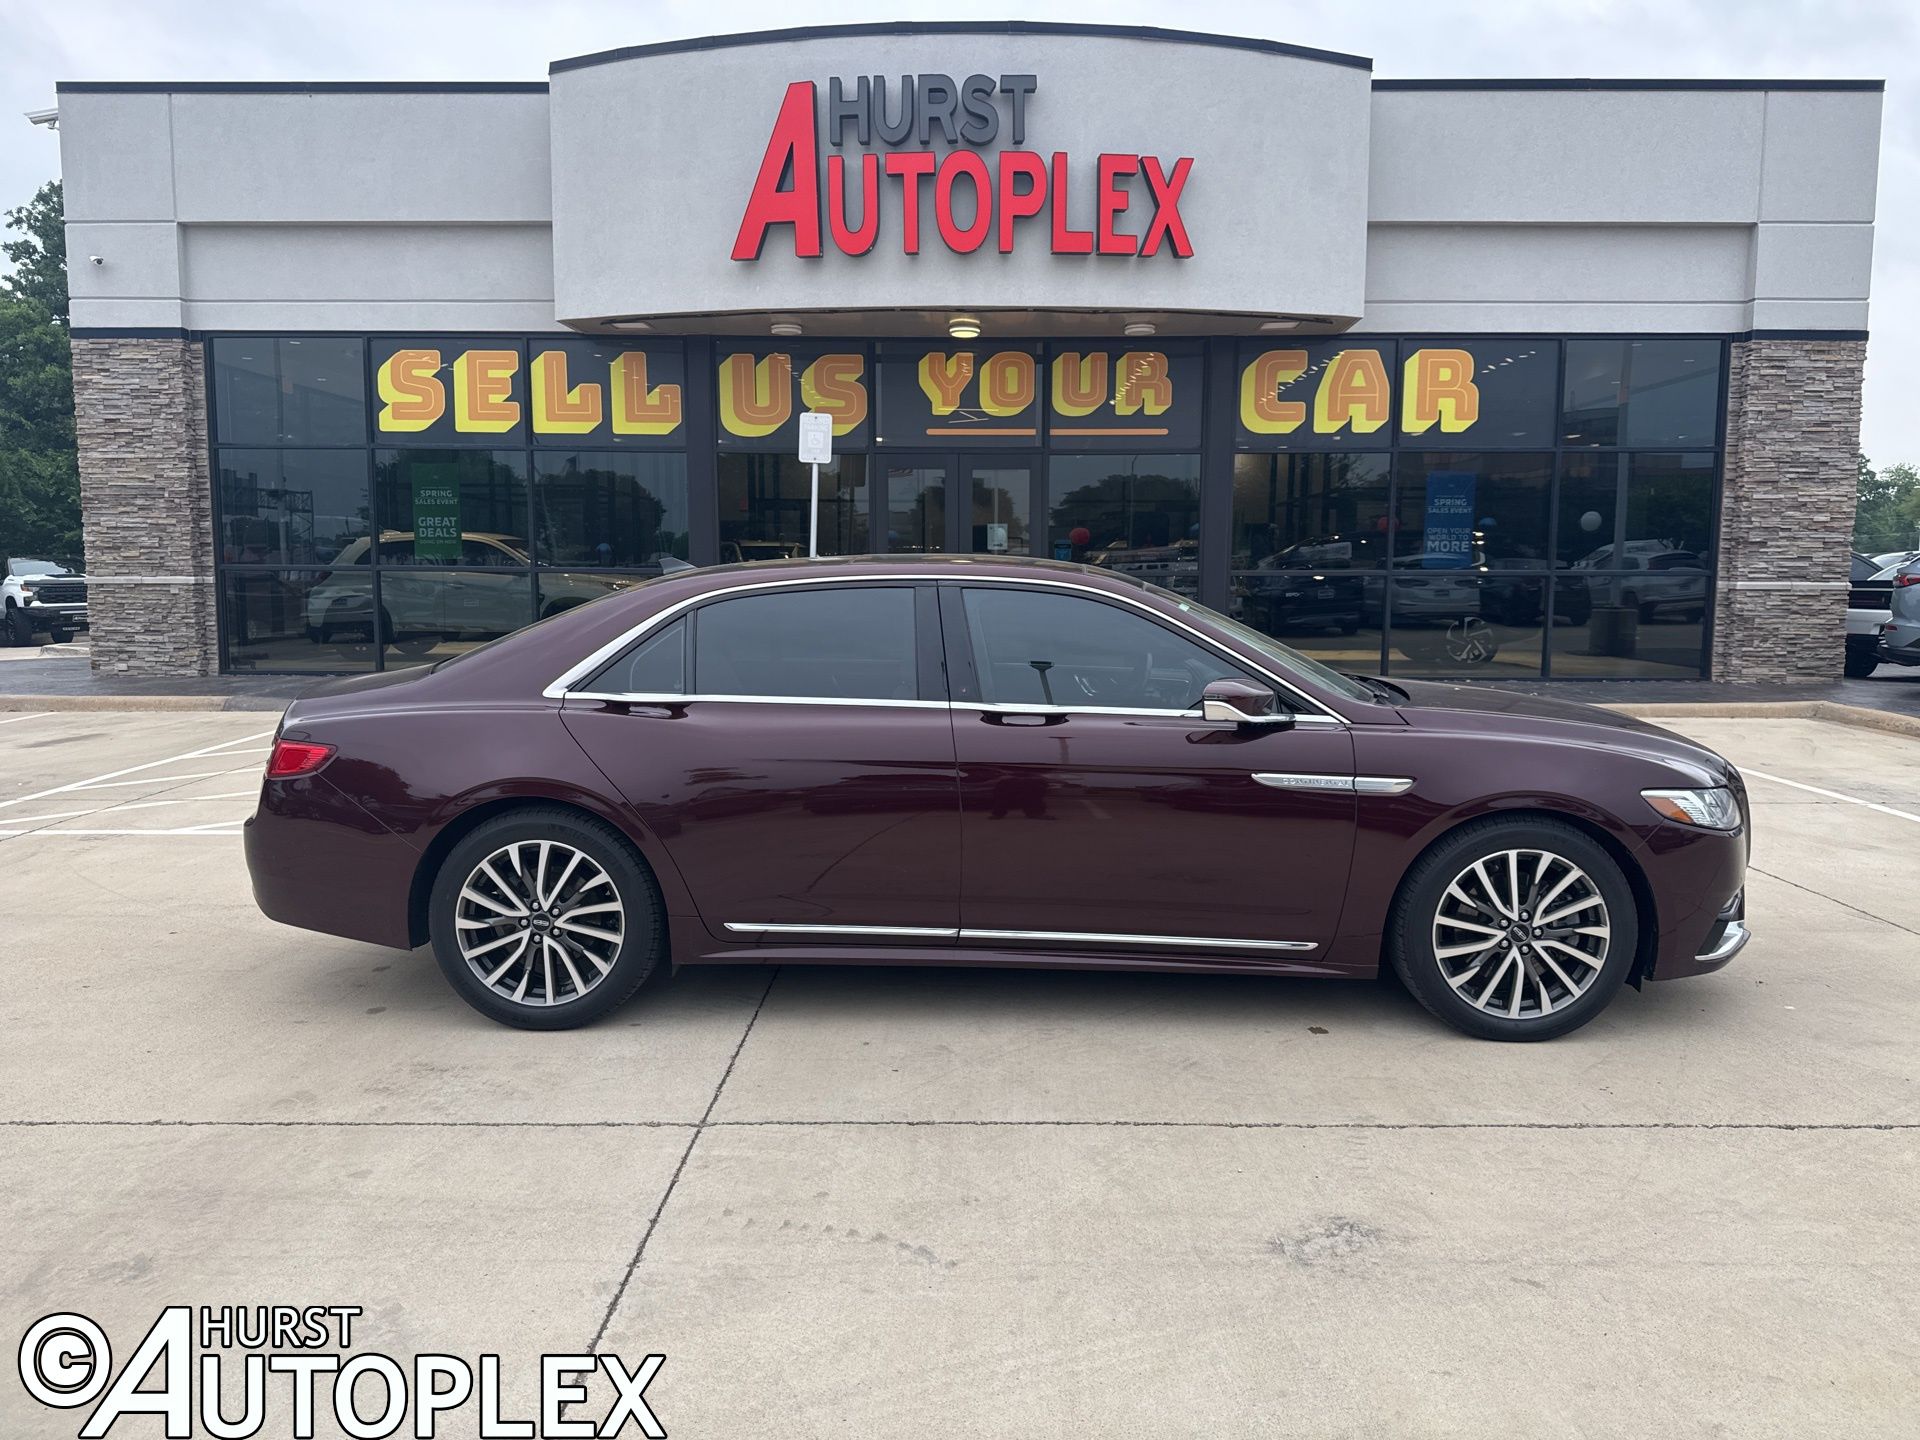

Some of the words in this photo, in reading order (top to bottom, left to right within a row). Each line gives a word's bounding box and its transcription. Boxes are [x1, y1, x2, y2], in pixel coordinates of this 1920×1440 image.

[829, 74, 1037, 147] HURST
[731, 81, 1195, 261] AUTOPLEX
[377, 349, 682, 436] SELL
[718, 352, 868, 438] US
[918, 351, 1173, 416] YOUR
[1240, 348, 1480, 434] CAR
[418, 517, 457, 527] GREAT
[419, 527, 457, 538] DEALS
[1427, 541, 1469, 552] MORE
